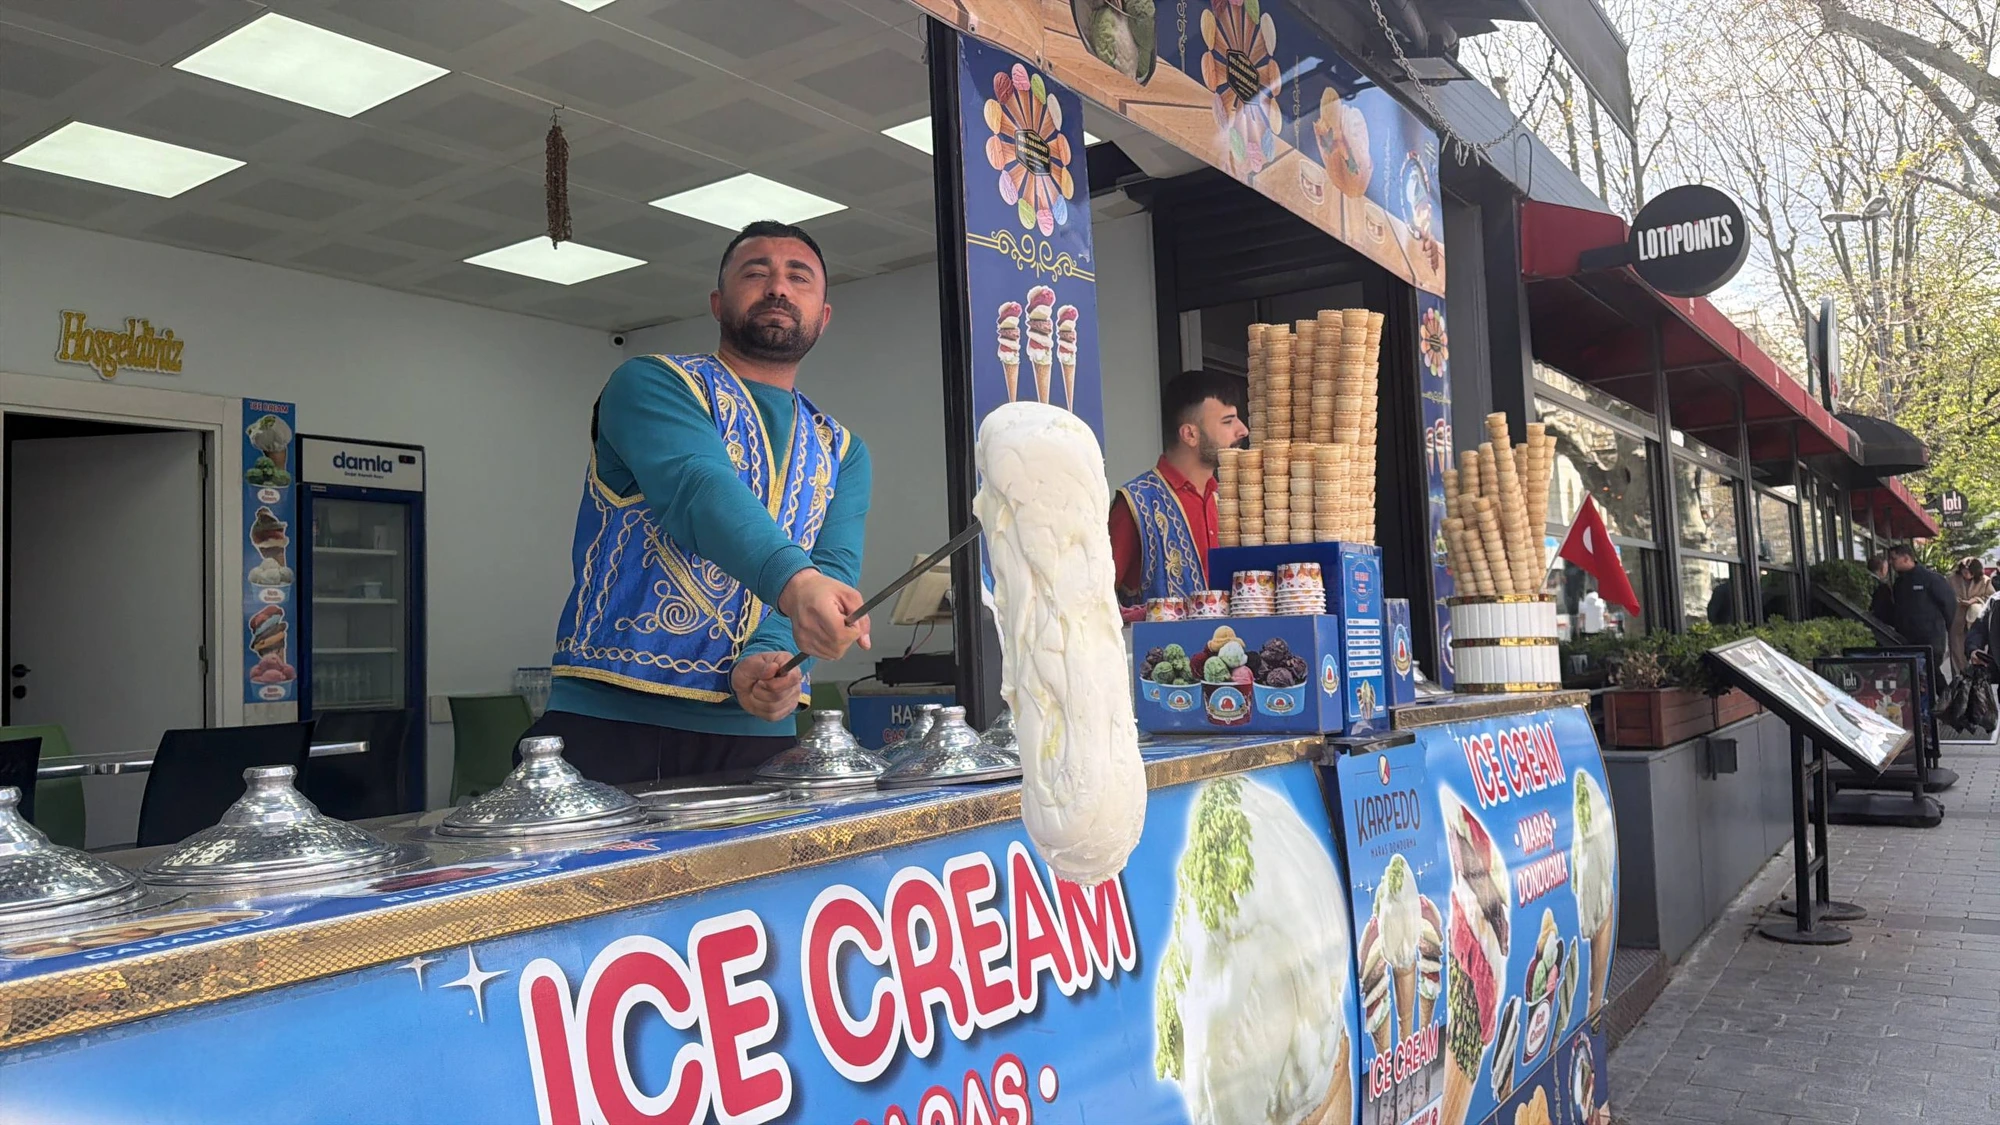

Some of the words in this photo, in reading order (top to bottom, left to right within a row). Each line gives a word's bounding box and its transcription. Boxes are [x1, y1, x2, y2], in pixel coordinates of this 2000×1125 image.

[333, 451, 393, 474] damla
[1942, 490, 1962, 511] loti
[1462, 730, 1510, 810] ICE
[1498, 721, 1566, 799] CREAM
[758, 815, 822, 830] LEMON
[1354, 788, 1420, 848] KARPEDO
[1518, 811, 1554, 853] MARAŞ
[382, 865, 563, 903] BLACKBERRY
[1517, 851, 1569, 908] DONDURMA
[84, 922, 272, 960] CARAMEL
[519, 909, 792, 1125] ICE
[800, 841, 1136, 1083] CREAM
[1369, 1048, 1392, 1103] ICE
[1394, 1020, 1440, 1085] CREAM
